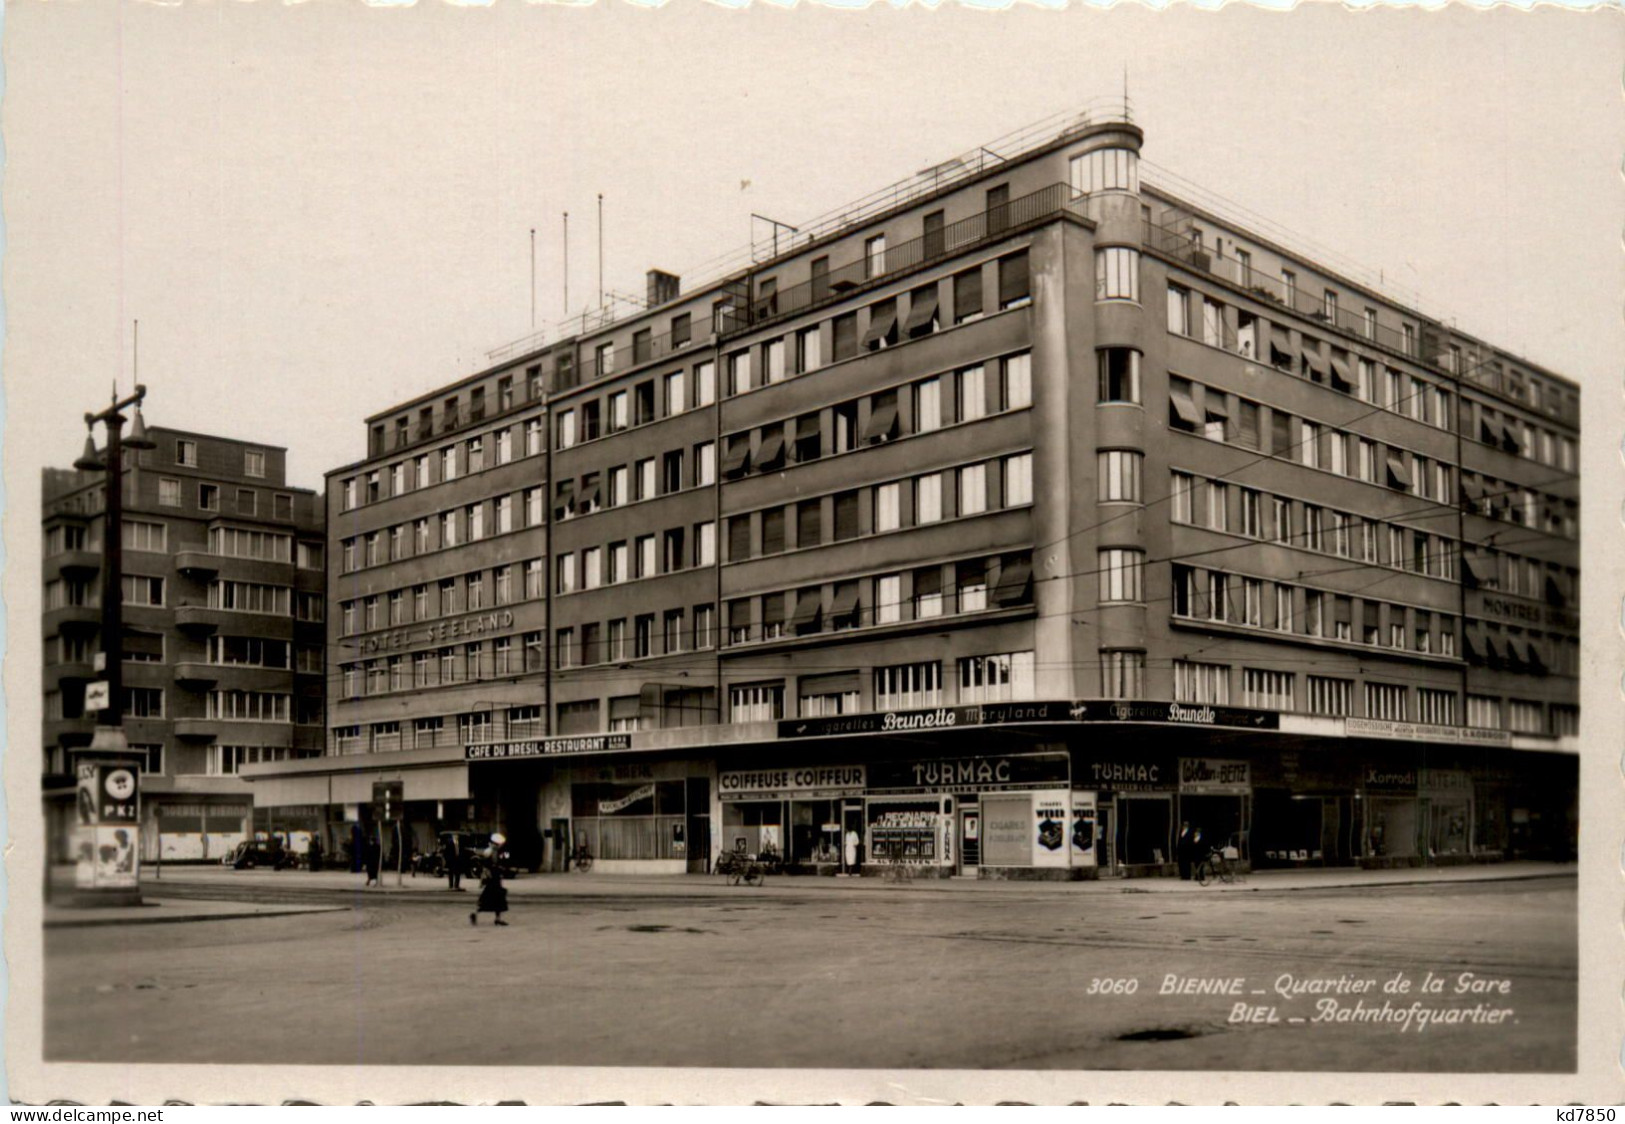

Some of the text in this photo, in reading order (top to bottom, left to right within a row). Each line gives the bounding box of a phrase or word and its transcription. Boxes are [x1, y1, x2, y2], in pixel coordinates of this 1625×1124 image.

[359, 610, 514, 654] HOTEL SEELAND
[815, 703, 1048, 736] igarettes Brunette Maryland
[1168, 703, 1216, 723] Brunette
[494, 744, 505, 757] DU
[545, 738, 605, 753] RESTAURANT
[722, 768, 862, 789] COIFFEUSE COIFFEUR
[912, 759, 1010, 785] TURMAC
[1091, 762, 1159, 782] TURMAC
[1366, 768, 1415, 785] Korrodi
[104, 804, 135, 817] PKZ
[1036, 809, 1065, 818] WEBER
